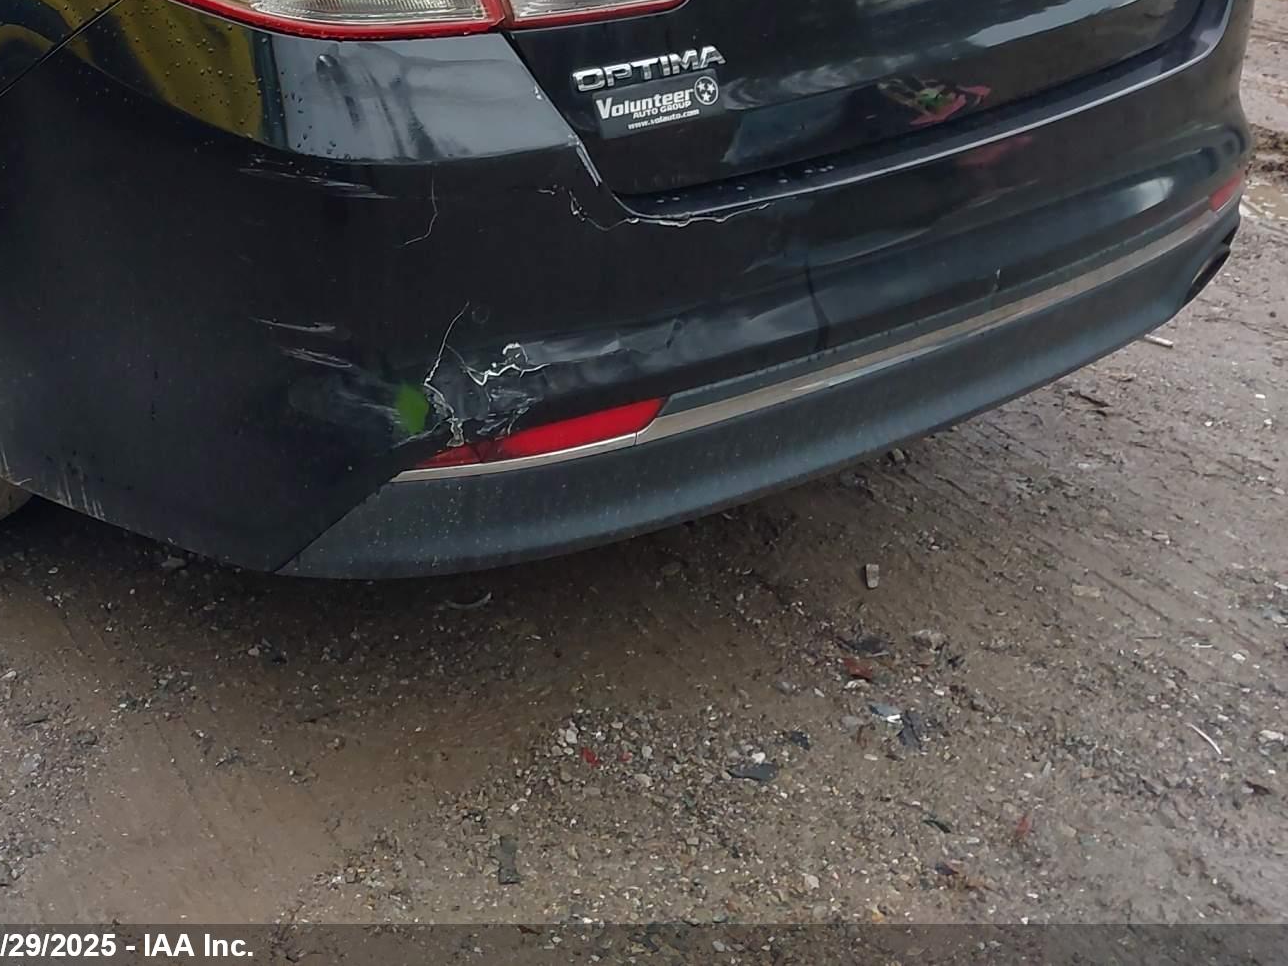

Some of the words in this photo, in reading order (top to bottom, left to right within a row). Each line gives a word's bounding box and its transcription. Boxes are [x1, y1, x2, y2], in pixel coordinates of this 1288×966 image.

[572, 45, 726, 92] OPTIMA
[595, 89, 695, 120] Volunteer
[632, 108, 659, 120] AUTO
[660, 100, 692, 113] GROUP
[627, 109, 700, 130] www.volauto.com
